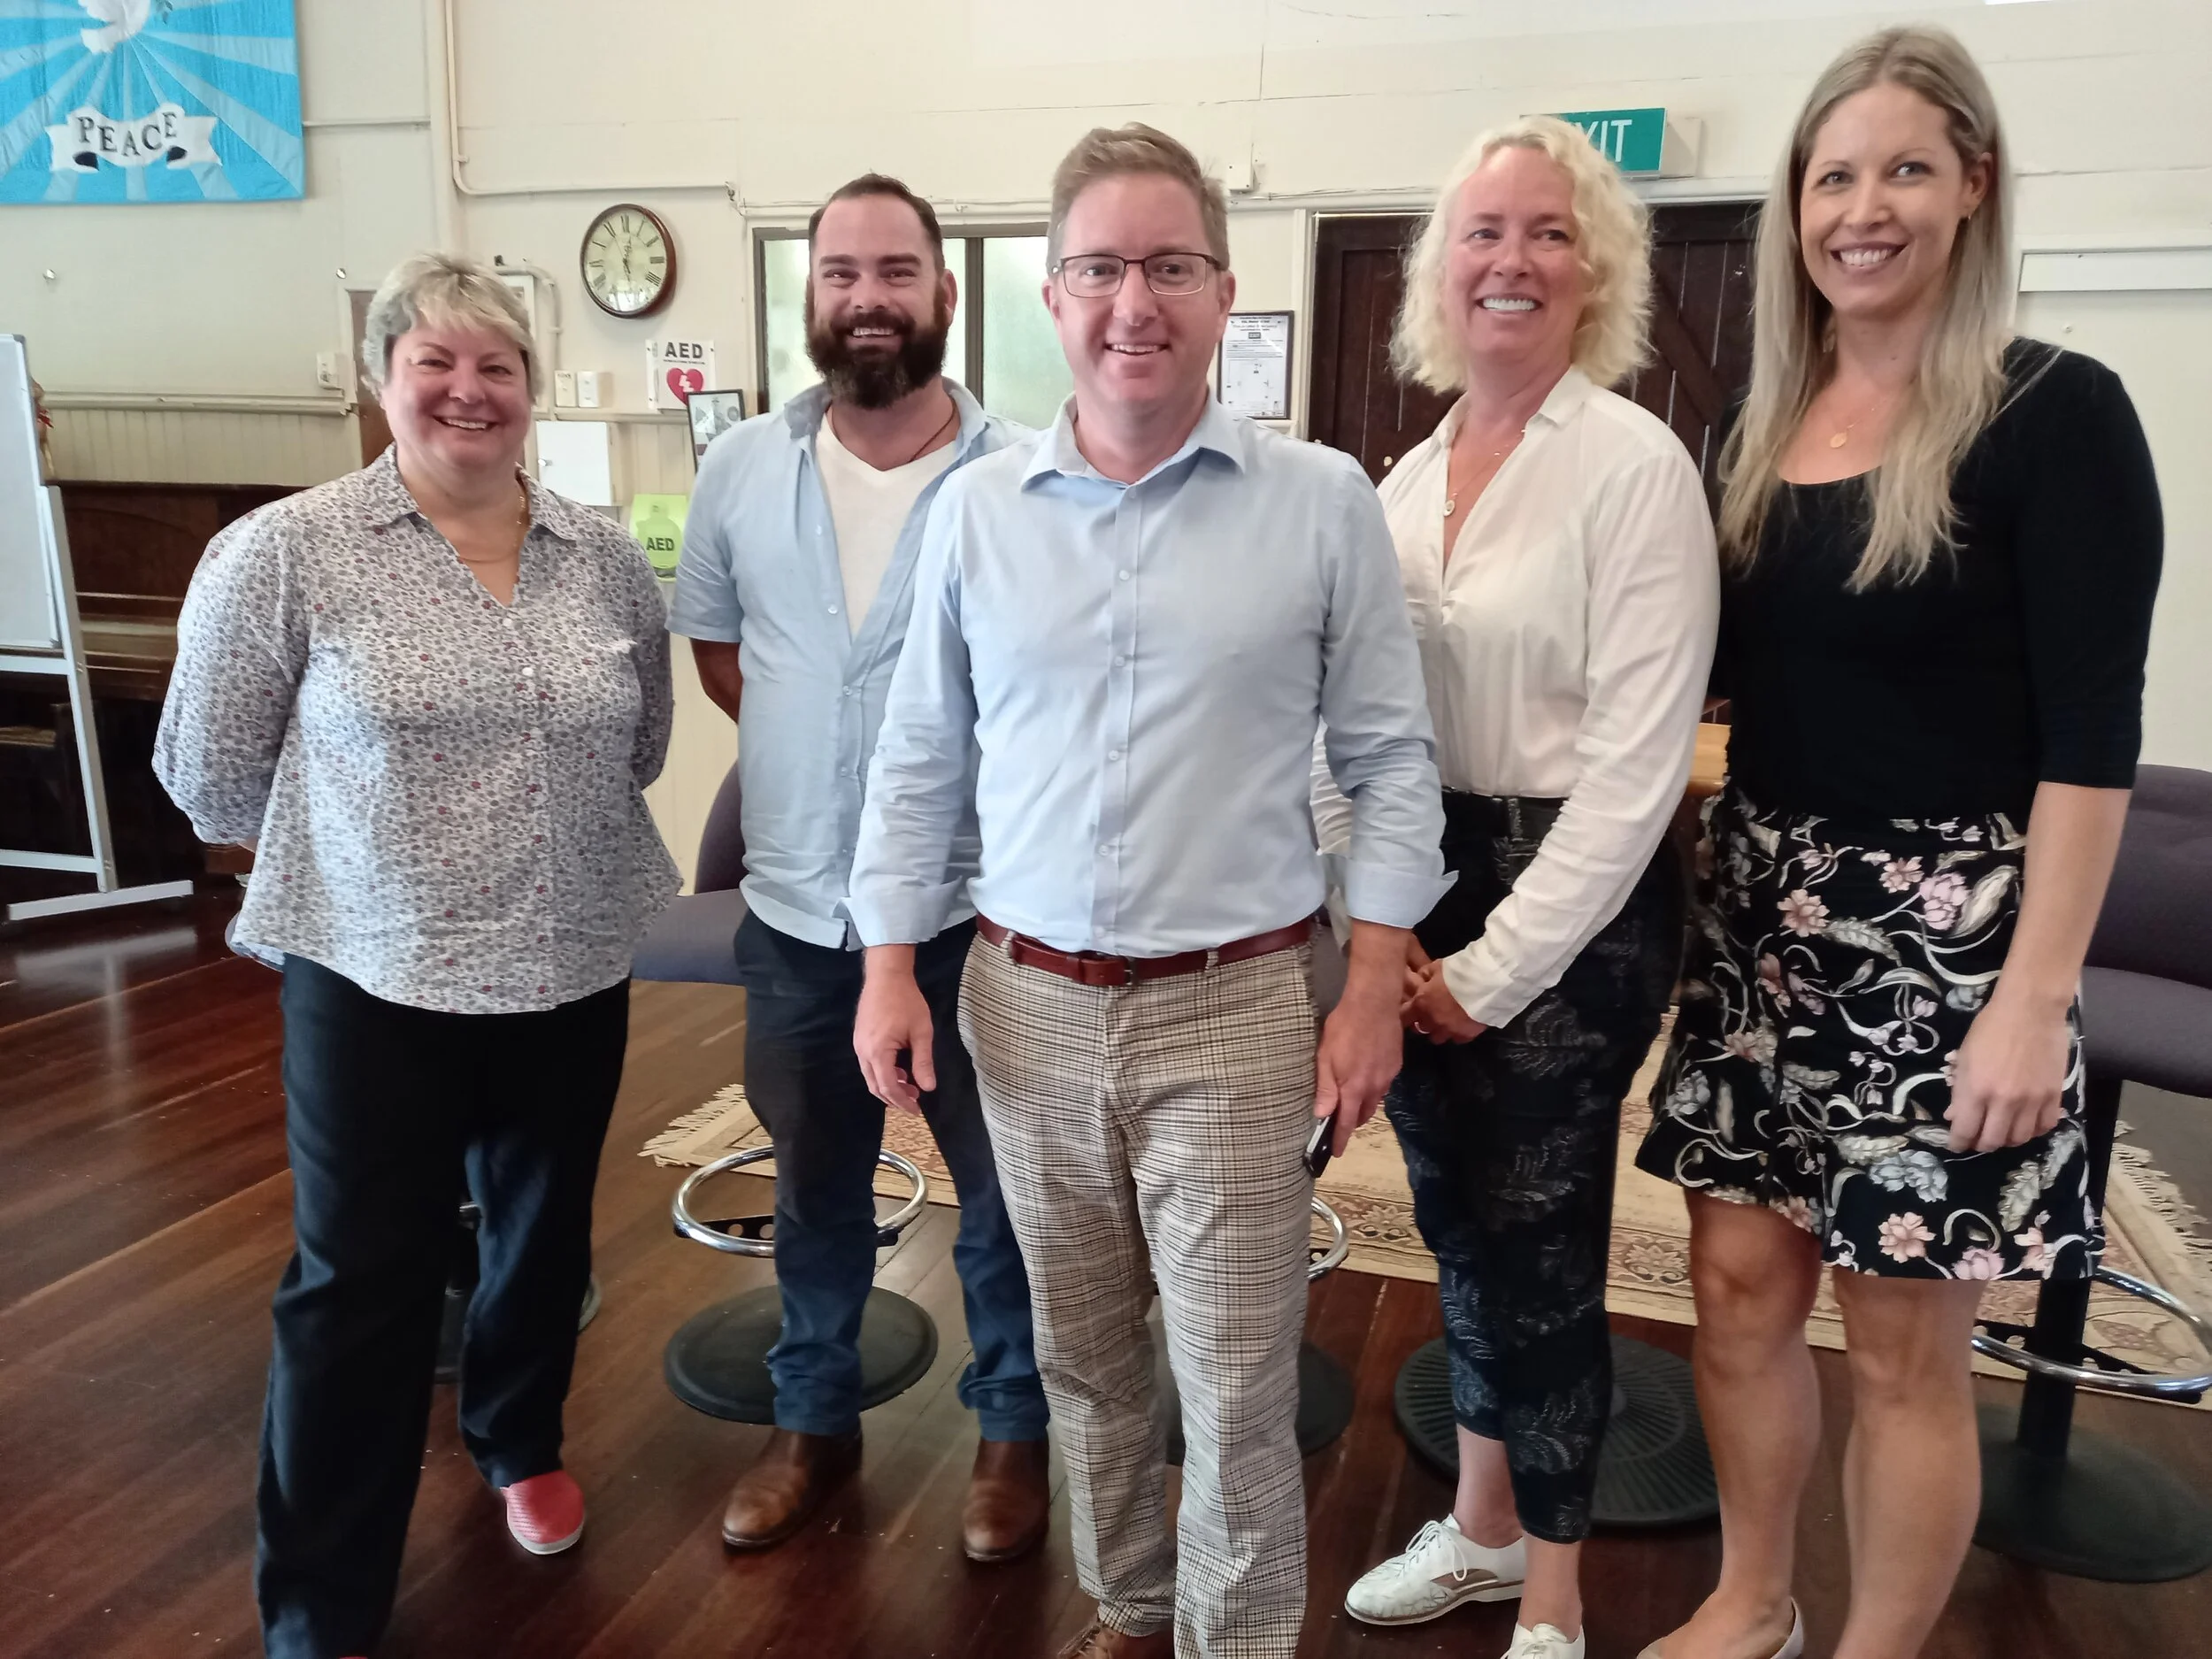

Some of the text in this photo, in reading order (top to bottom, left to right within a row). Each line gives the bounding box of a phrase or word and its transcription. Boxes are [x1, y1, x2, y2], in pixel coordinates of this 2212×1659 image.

[77, 111, 177, 157] PEACE
[664, 342, 703, 359] AED
[646, 536, 675, 551] AED
